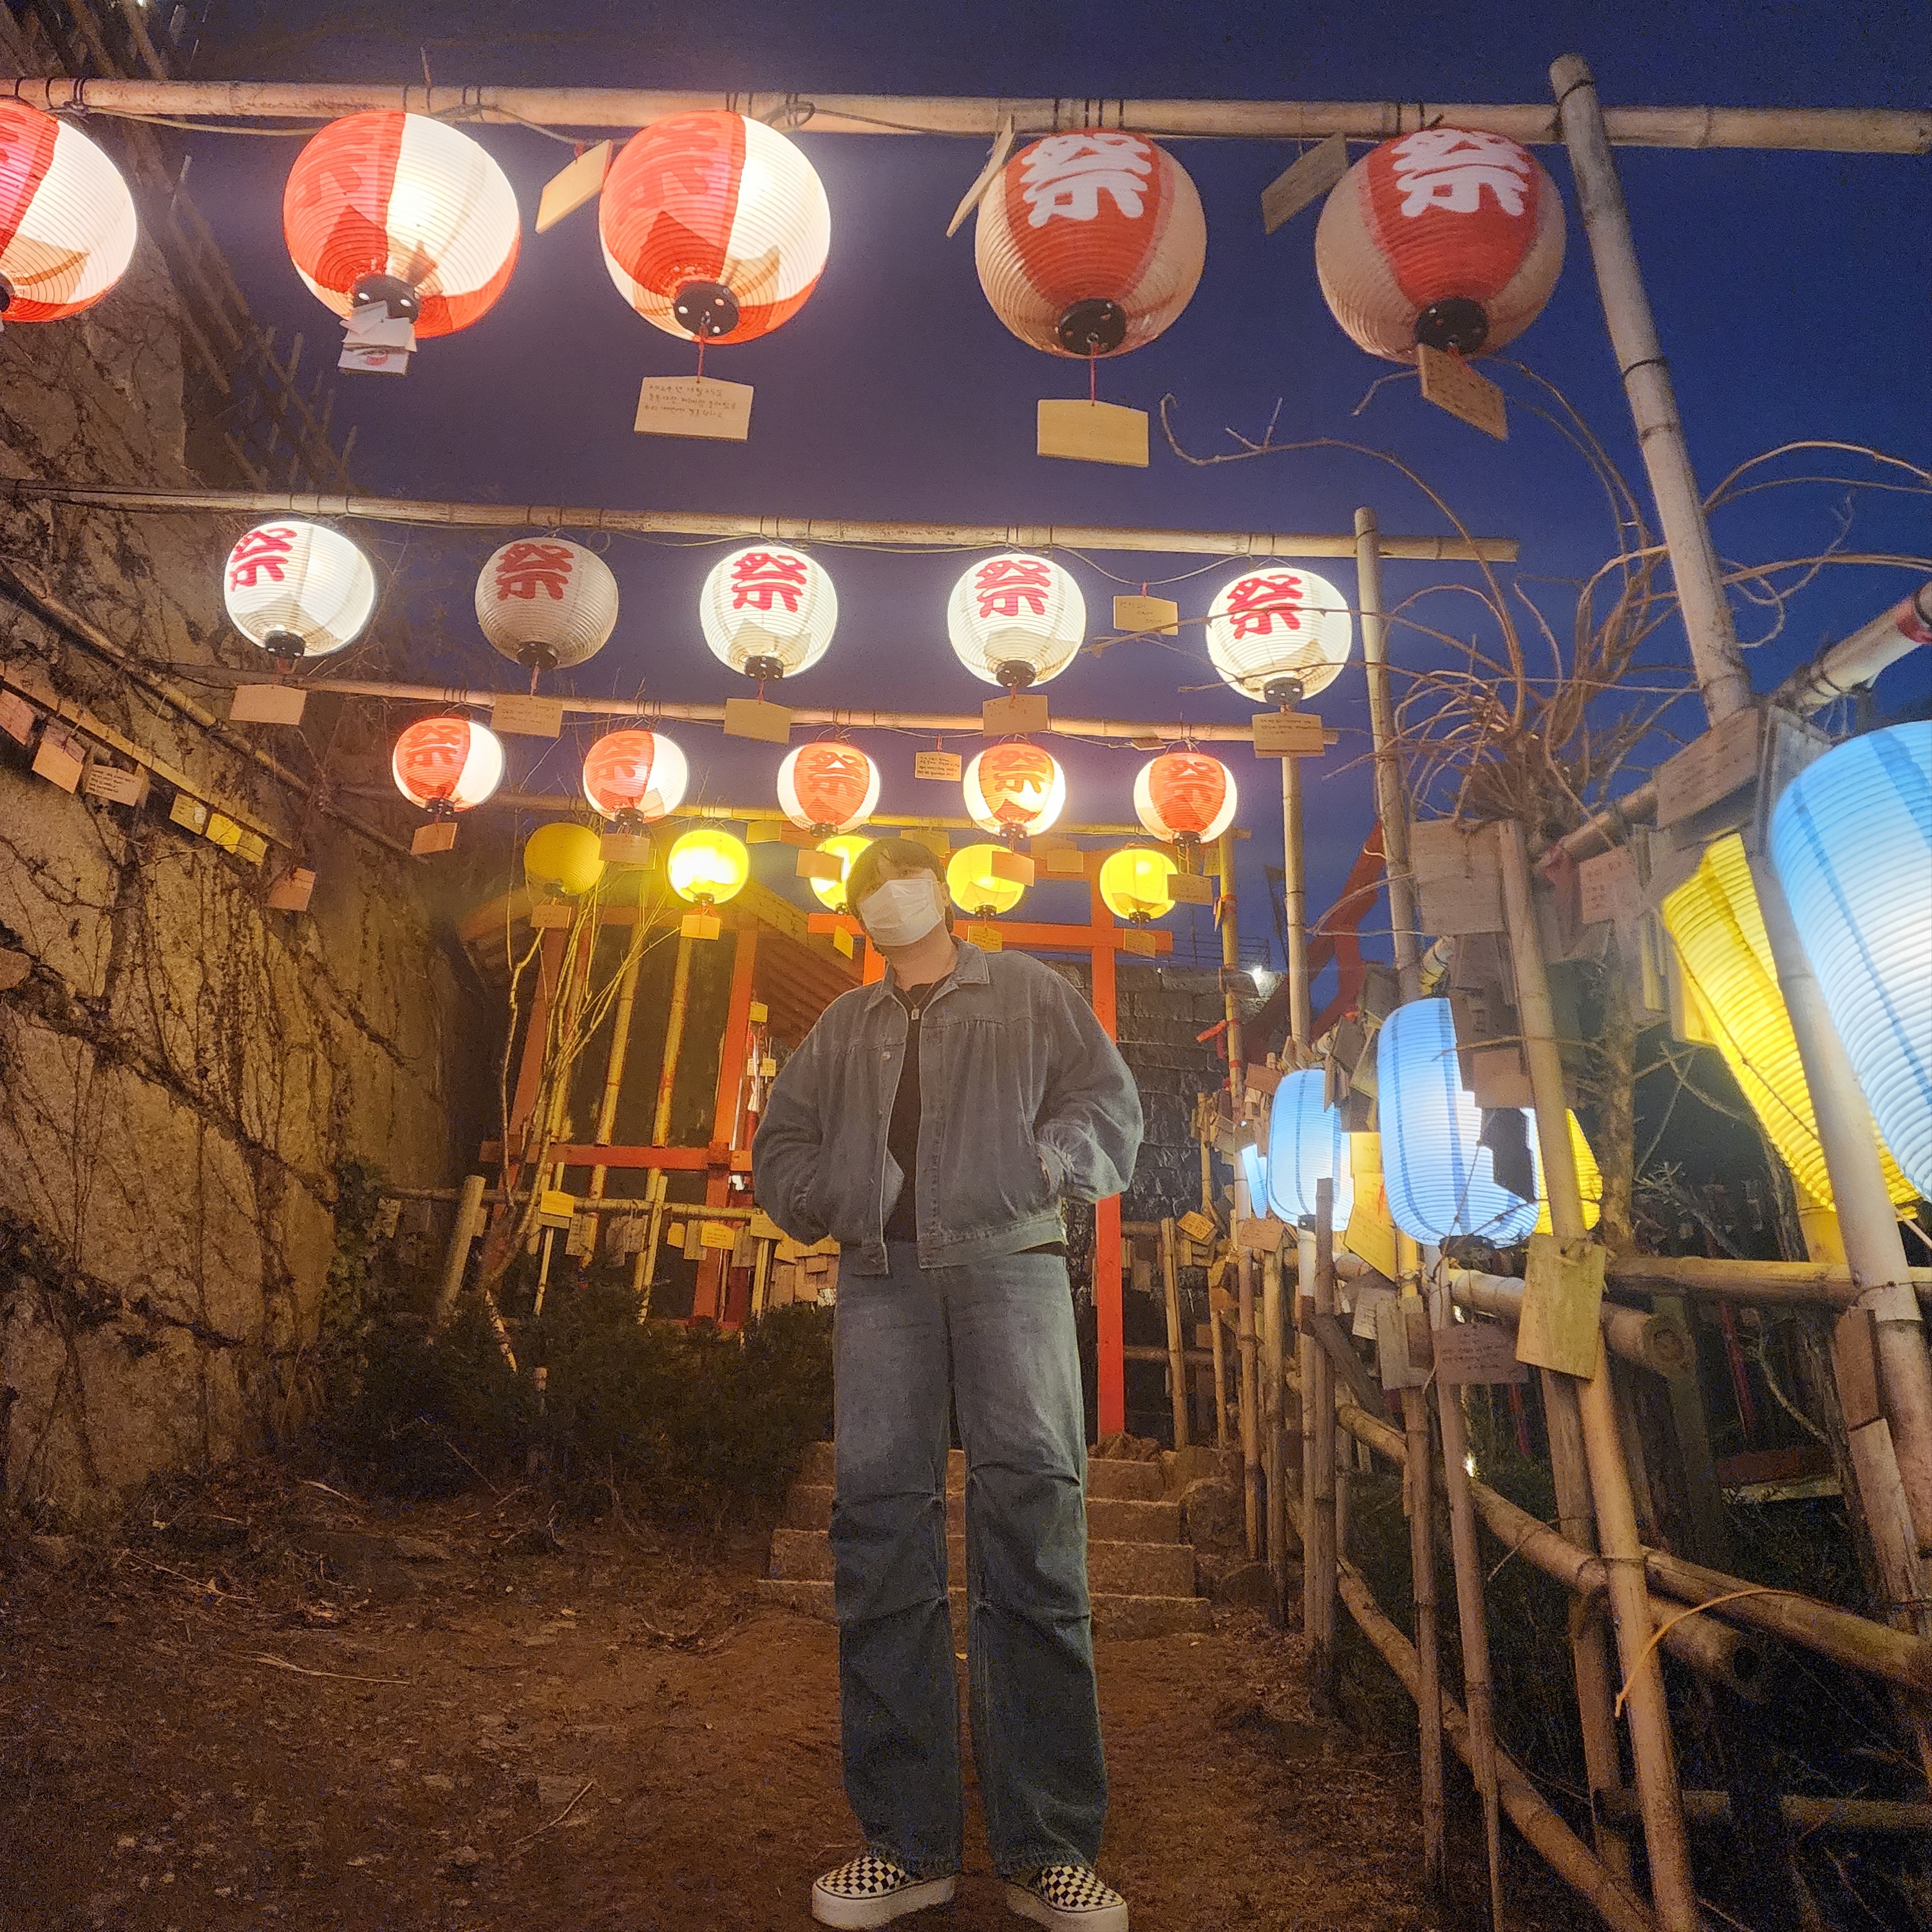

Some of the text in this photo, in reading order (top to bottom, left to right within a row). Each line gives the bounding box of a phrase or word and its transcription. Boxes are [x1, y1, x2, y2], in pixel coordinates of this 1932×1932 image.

[1019, 133, 1152, 228] 祭
[1392, 129, 1531, 217] 祭
[229, 527, 297, 592] 祭
[495, 543, 574, 601] 祭
[731, 552, 808, 613] 祭
[974, 560, 1051, 618] 祭
[1227, 574, 1303, 639] 祭
[405, 725, 462, 768] 祭
[808, 750, 863, 798] 祭
[992, 750, 1047, 794] 祭
